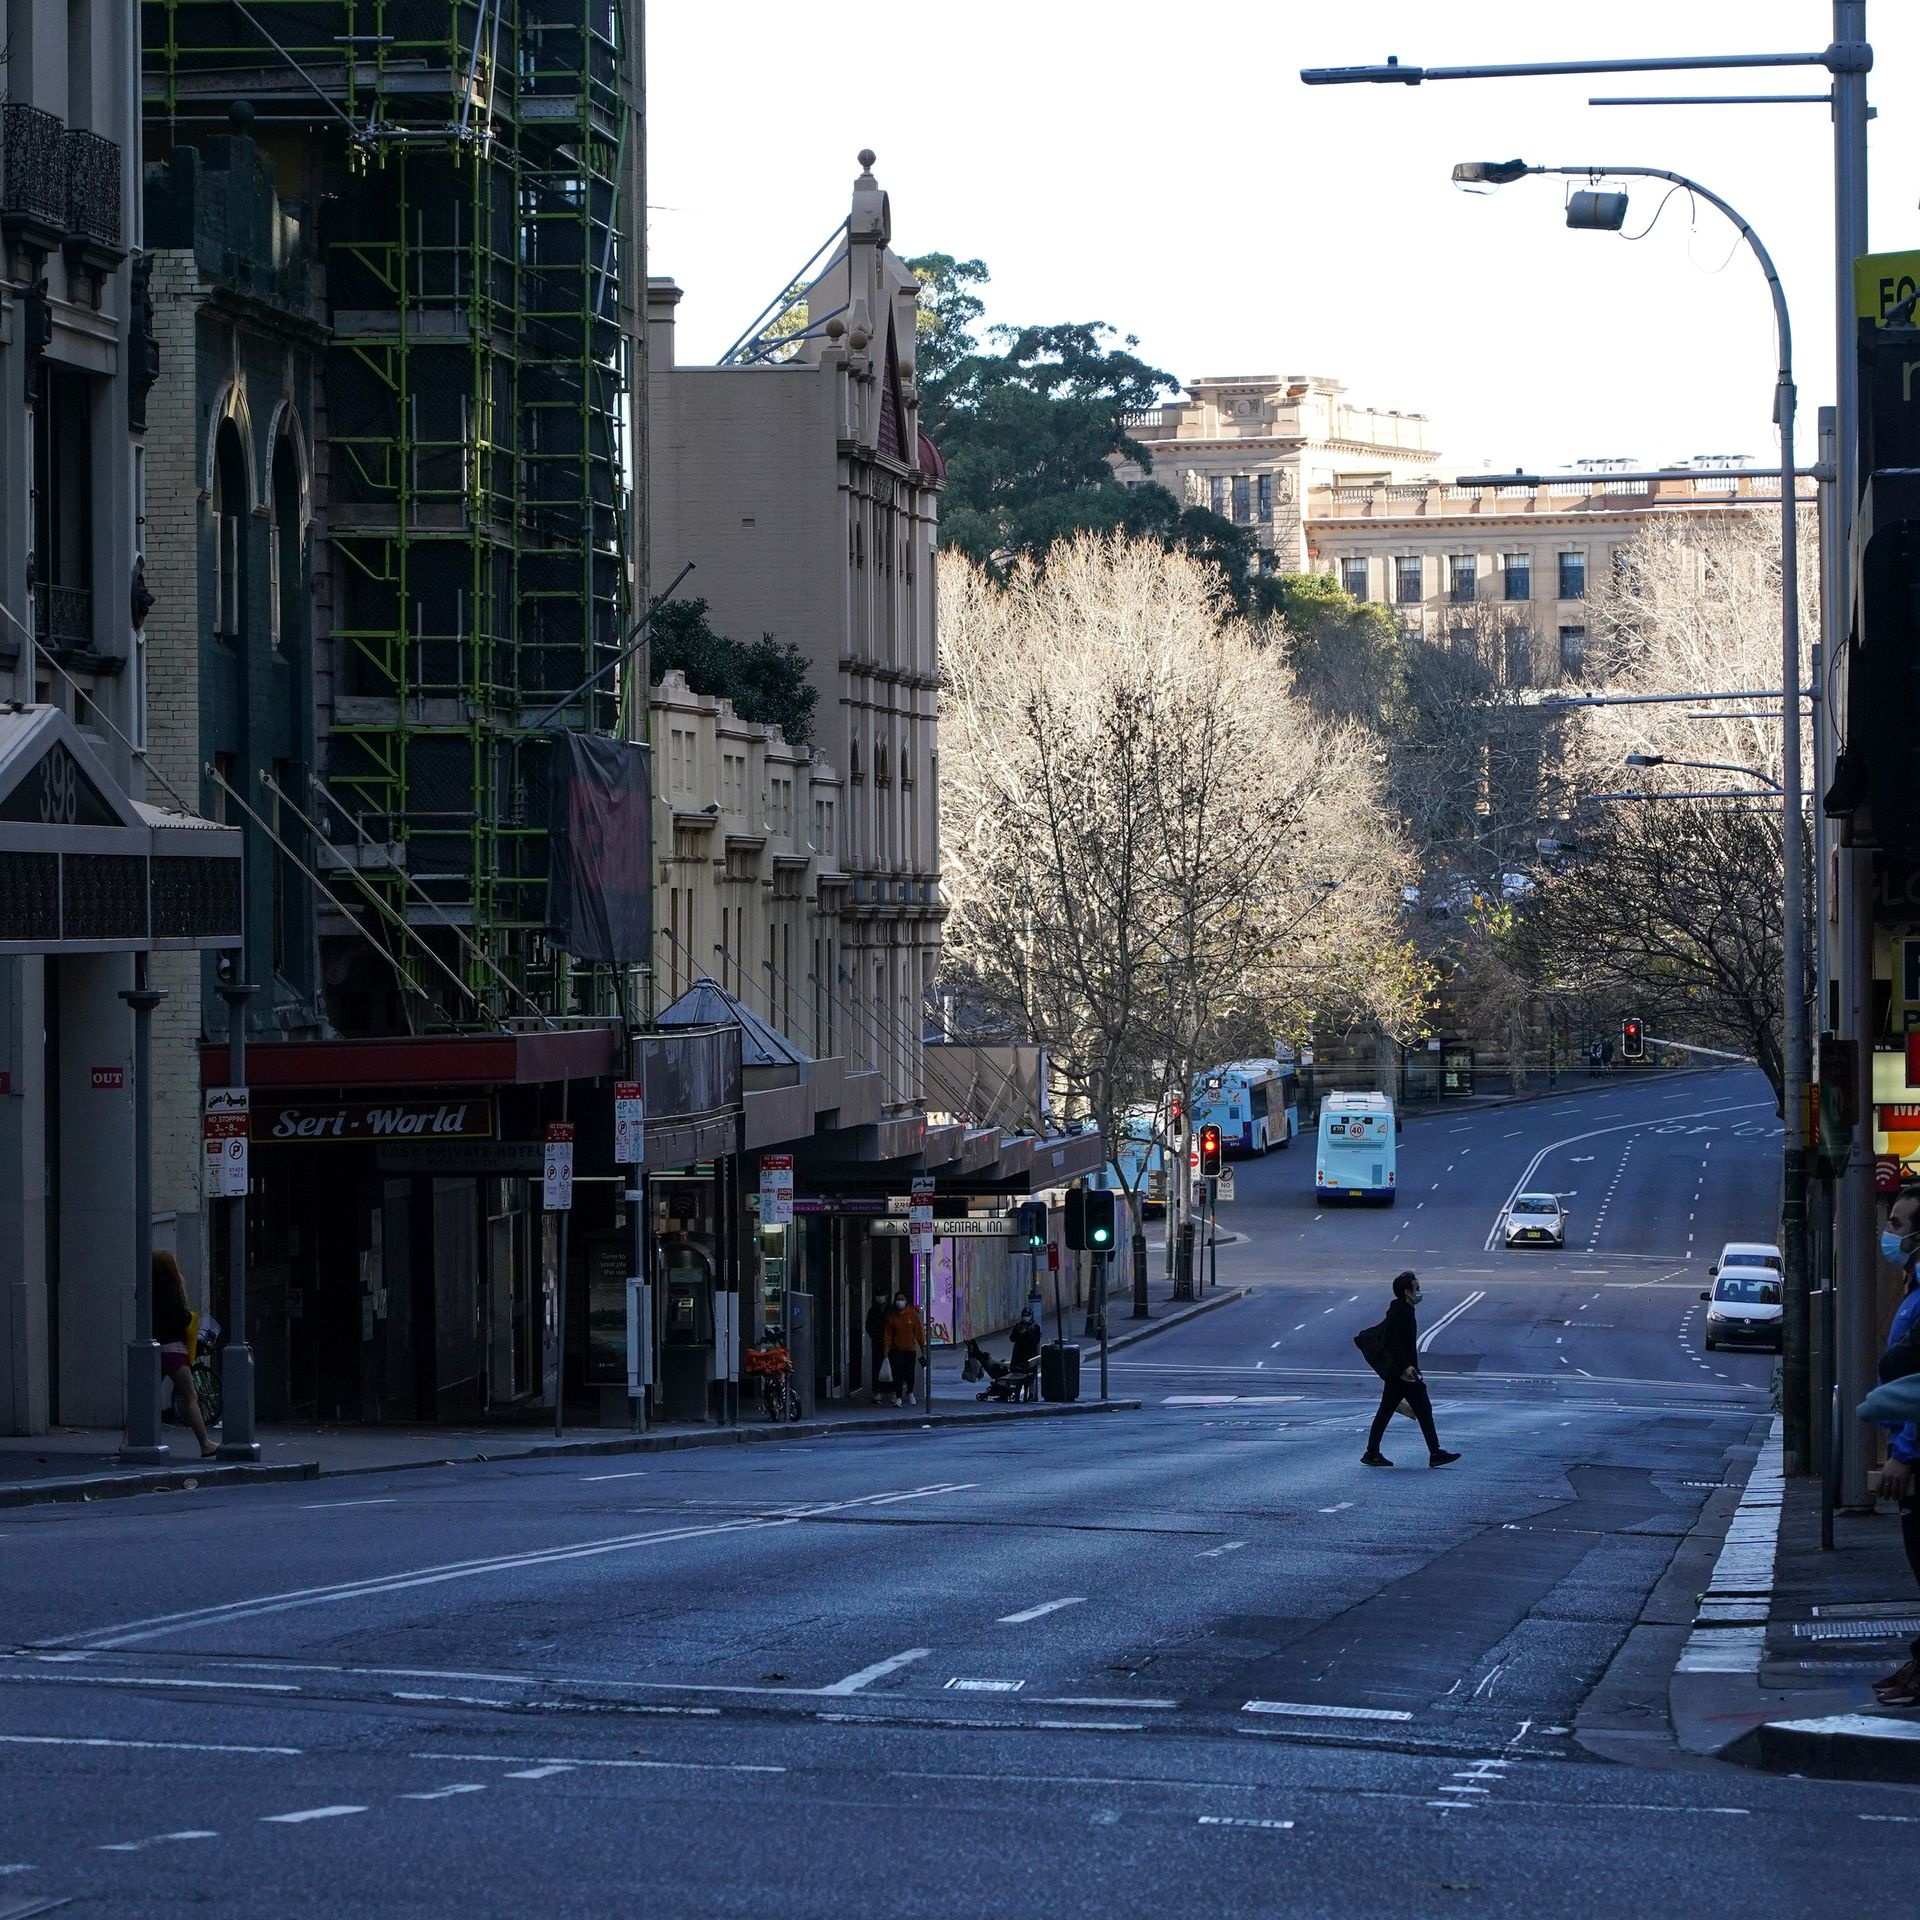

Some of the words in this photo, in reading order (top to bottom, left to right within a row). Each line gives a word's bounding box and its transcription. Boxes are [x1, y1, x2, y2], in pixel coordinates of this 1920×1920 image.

[40, 747, 77, 824] 398
[93, 1073, 122, 1084] OUT
[208, 1115, 217, 1123] NO
[218, 1115, 246, 1123] STOPPING
[272, 1109, 348, 1138] Seri
[366, 1104, 468, 1135] World
[1352, 1126, 1362, 1134] 40
[428, 1146, 490, 1158] PRIVATE
[497, 1145, 544, 1157] HOTEL
[944, 1221, 982, 1233] CENTRAL
[986, 1221, 1002, 1233] INN
